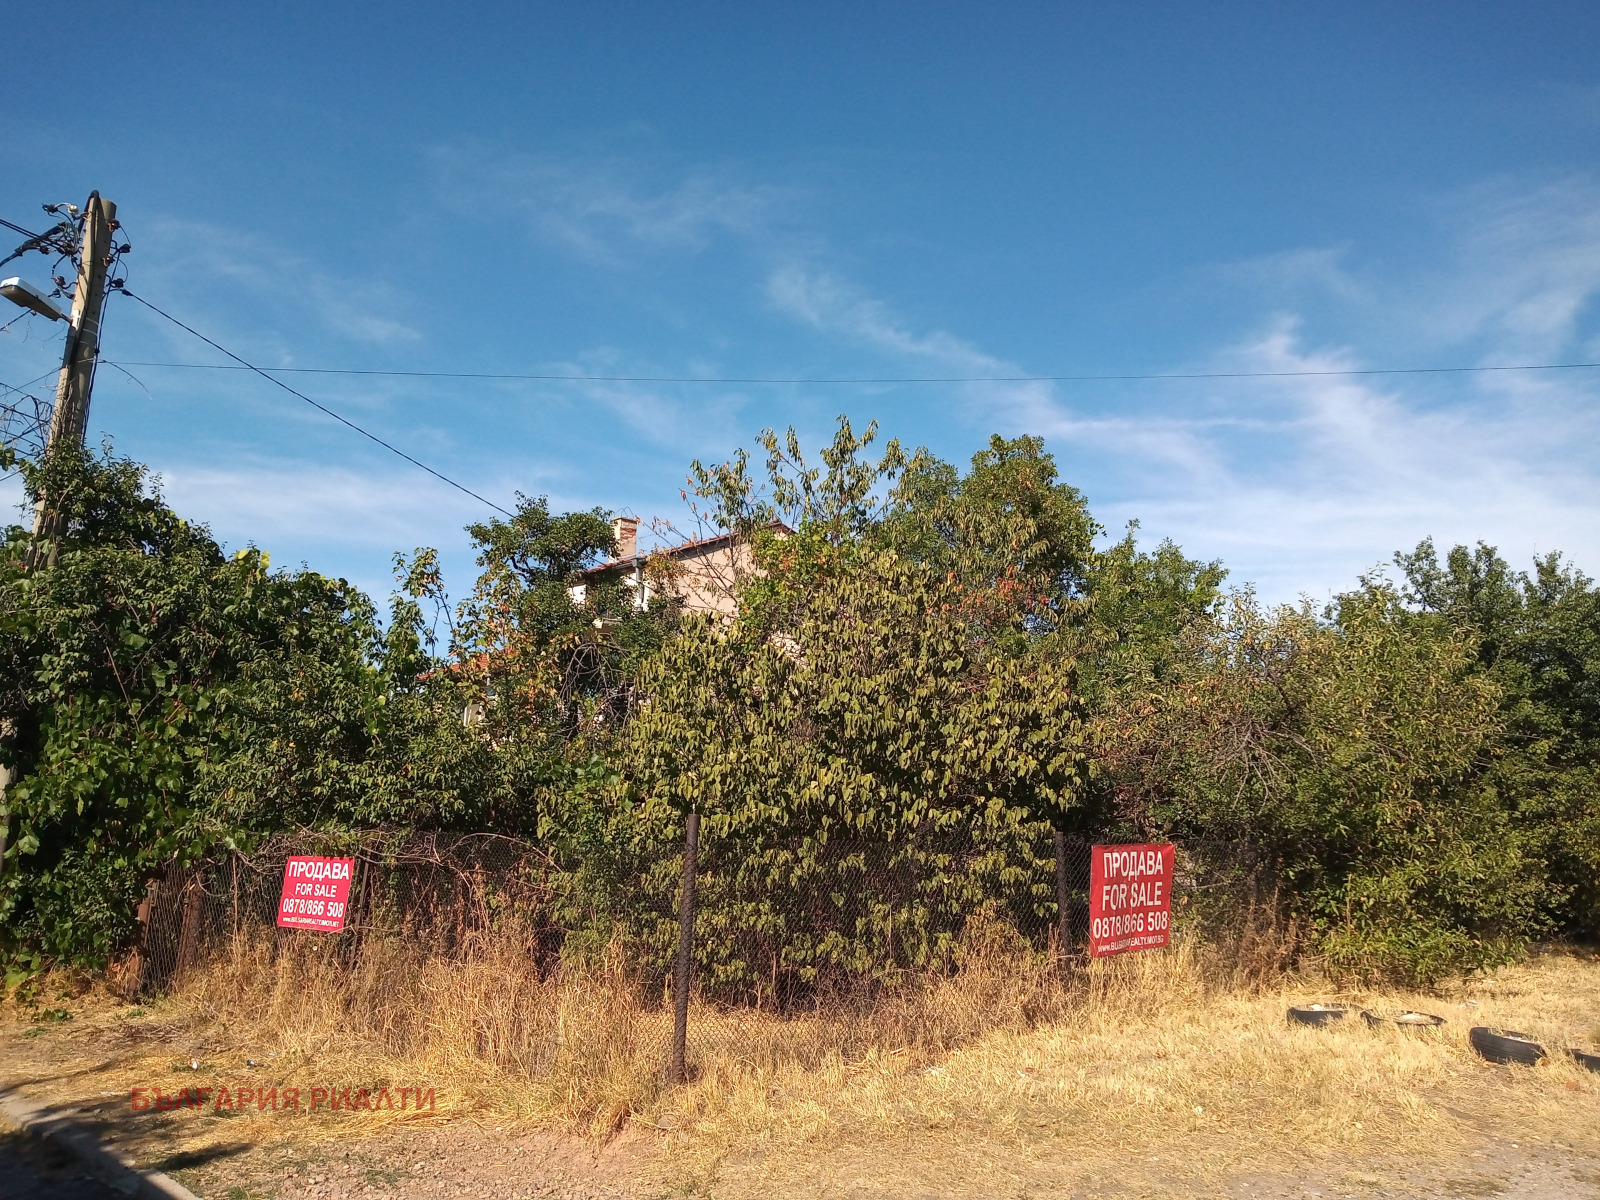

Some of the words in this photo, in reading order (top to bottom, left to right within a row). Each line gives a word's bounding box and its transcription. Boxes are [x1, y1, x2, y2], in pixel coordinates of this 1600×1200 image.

[288, 861, 349, 881] ПРОДАВА
[1103, 851, 1164, 881] ПРОДАВА
[295, 883, 313, 896] FOR
[314, 884, 338, 898] SALE
[1102, 883, 1127, 911] FOR
[1130, 881, 1163, 908] SALE
[282, 898, 325, 916] 0878/866
[326, 902, 344, 918] 508
[1093, 912, 1144, 939] 0878/866
[1147, 911, 1168, 931] 508
